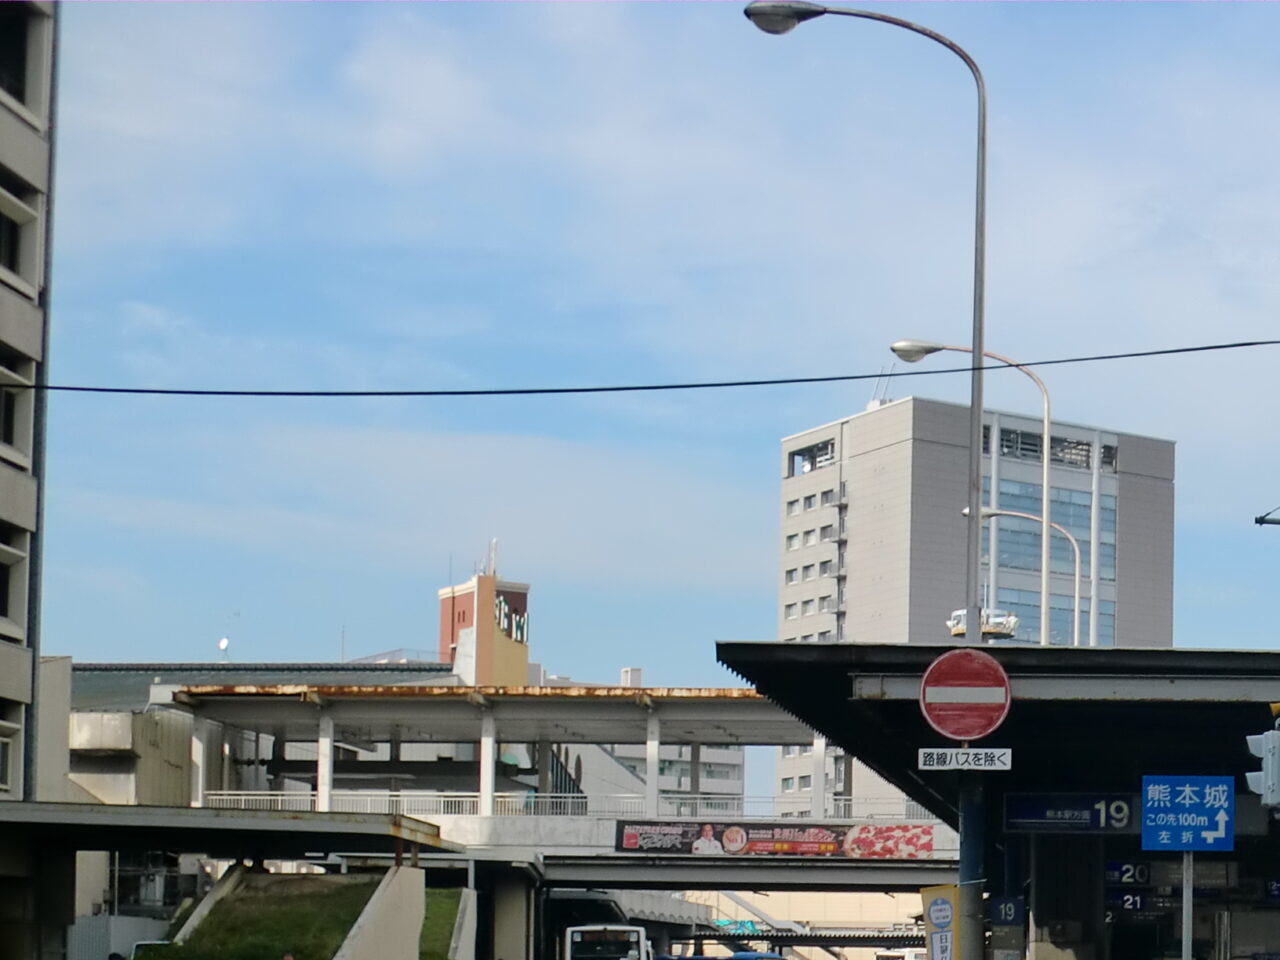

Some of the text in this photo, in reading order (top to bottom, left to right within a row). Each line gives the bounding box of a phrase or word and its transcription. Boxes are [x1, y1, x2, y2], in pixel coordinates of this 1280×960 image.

[922, 751, 1008, 767] 路線バスを除く
[1146, 784, 1229, 809] 熊本城
[1093, 799, 1130, 829] 19
[1146, 813, 1209, 827] この先100m
[1121, 864, 1149, 884] 20
[1123, 895, 1142, 910] 21
[1000, 903, 1016, 921] 19
